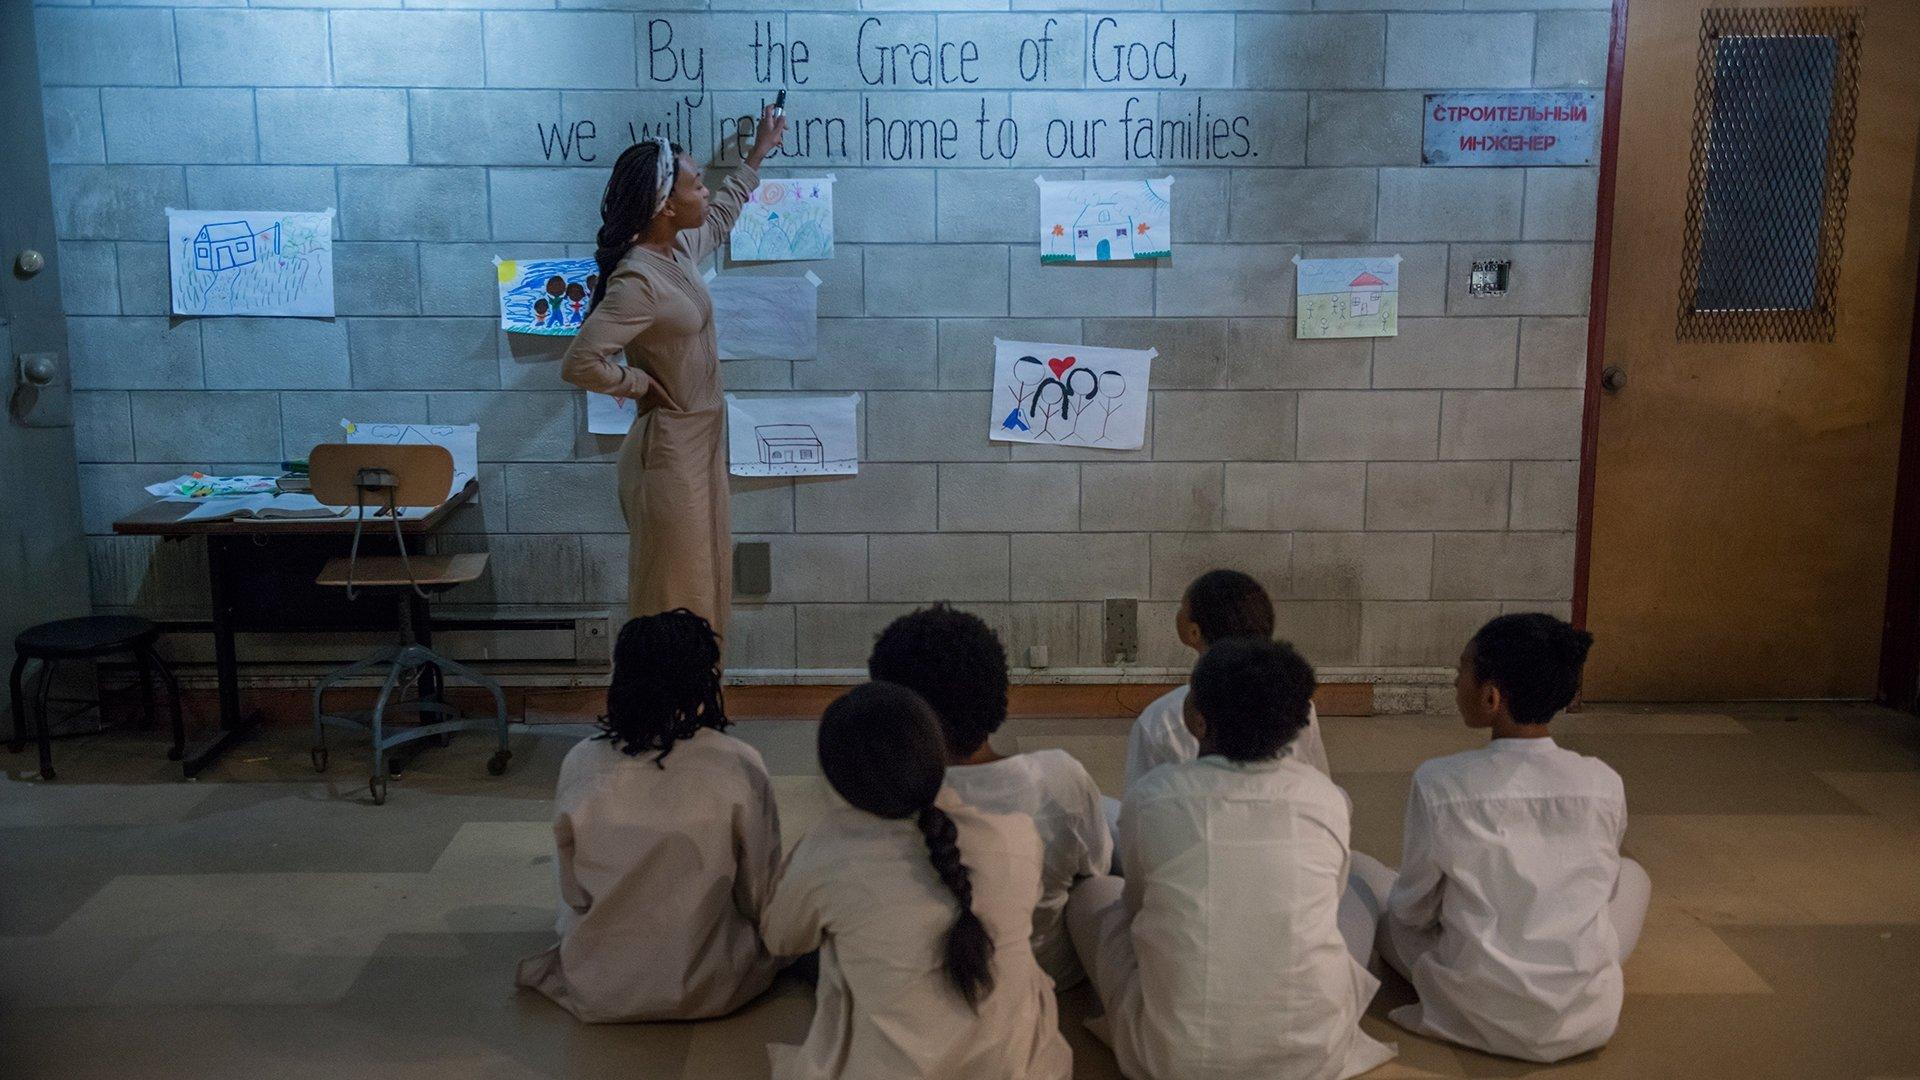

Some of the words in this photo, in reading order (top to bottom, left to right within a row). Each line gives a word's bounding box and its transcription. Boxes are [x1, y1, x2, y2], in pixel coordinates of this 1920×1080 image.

[648, 18, 705, 108] By
[748, 20, 810, 85] the
[856, 17, 979, 86] Grace
[1019, 18, 1058, 82] of
[1092, 17, 1187, 86] God,
[537, 119, 597, 162] we
[628, 100, 693, 156] will
[865, 97, 958, 161] home
[975, 97, 1018, 160] to
[1045, 117, 1107, 159] our
[1119, 97, 1259, 160] families.
[1432, 103, 1588, 122] СТРОИТЕЛЬНЫЙ
[1459, 134, 1557, 152] ИНЖЕНЕР
